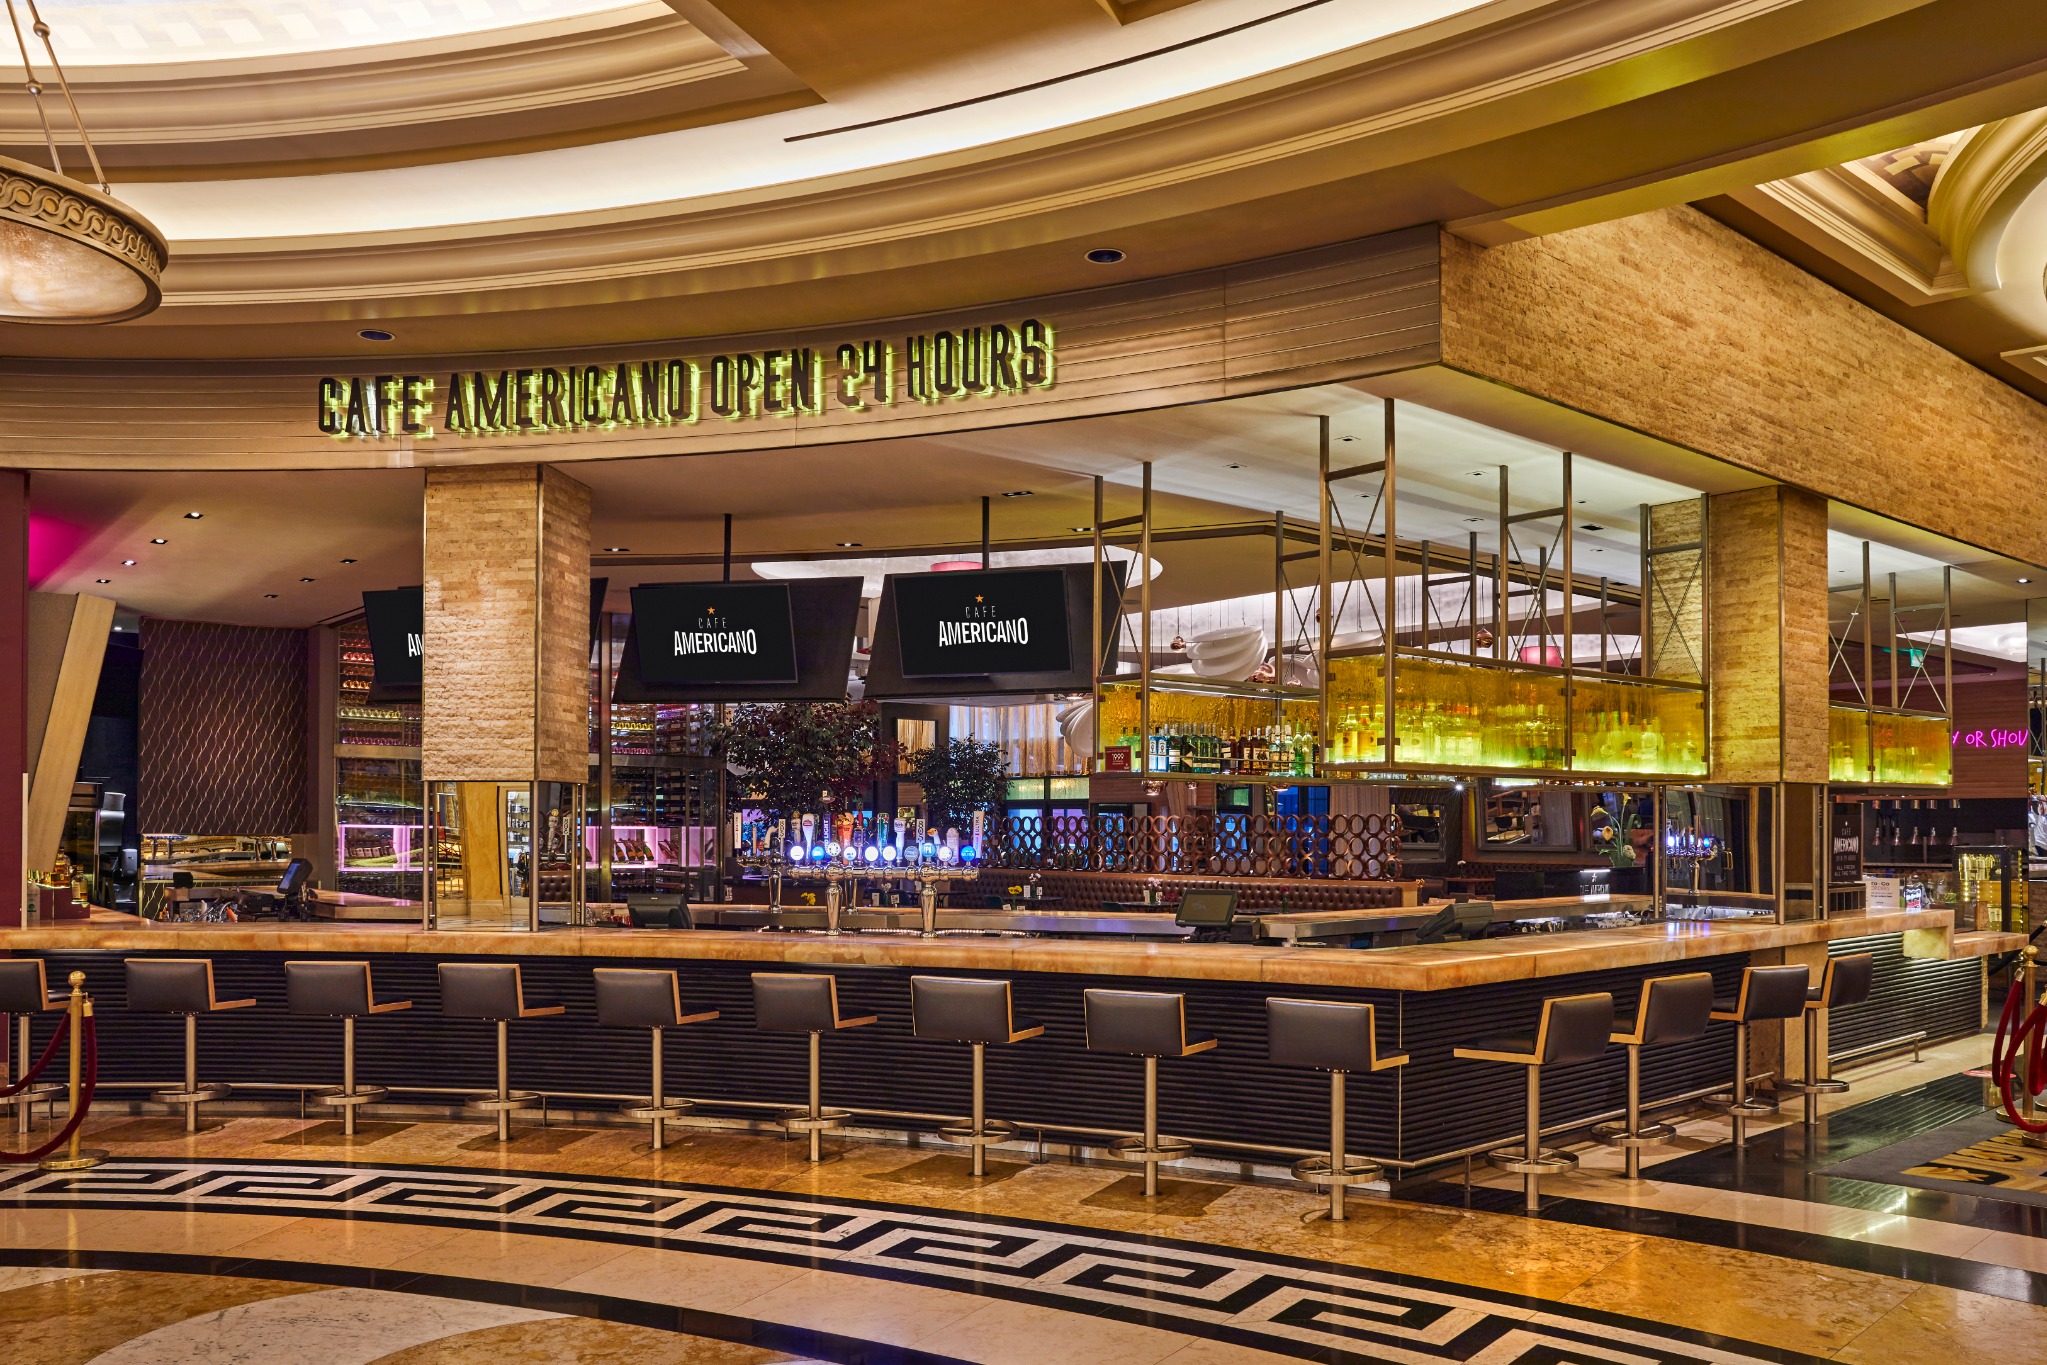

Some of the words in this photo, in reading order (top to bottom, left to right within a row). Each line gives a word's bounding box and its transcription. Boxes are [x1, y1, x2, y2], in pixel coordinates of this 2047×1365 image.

[319, 376, 432, 434] CAFE
[445, 360, 695, 430] AMERICANO
[711, 348, 818, 416] OPEN
[837, 340, 886, 406] 24
[907, 319, 1049, 400] HOURS
[966, 605, 996, 618] CAFE
[698, 617, 727, 629] CAFE
[939, 617, 1028, 647] AMERICANO
[674, 629, 757, 656] AMERICANO
[1965, 730, 1988, 748] OR
